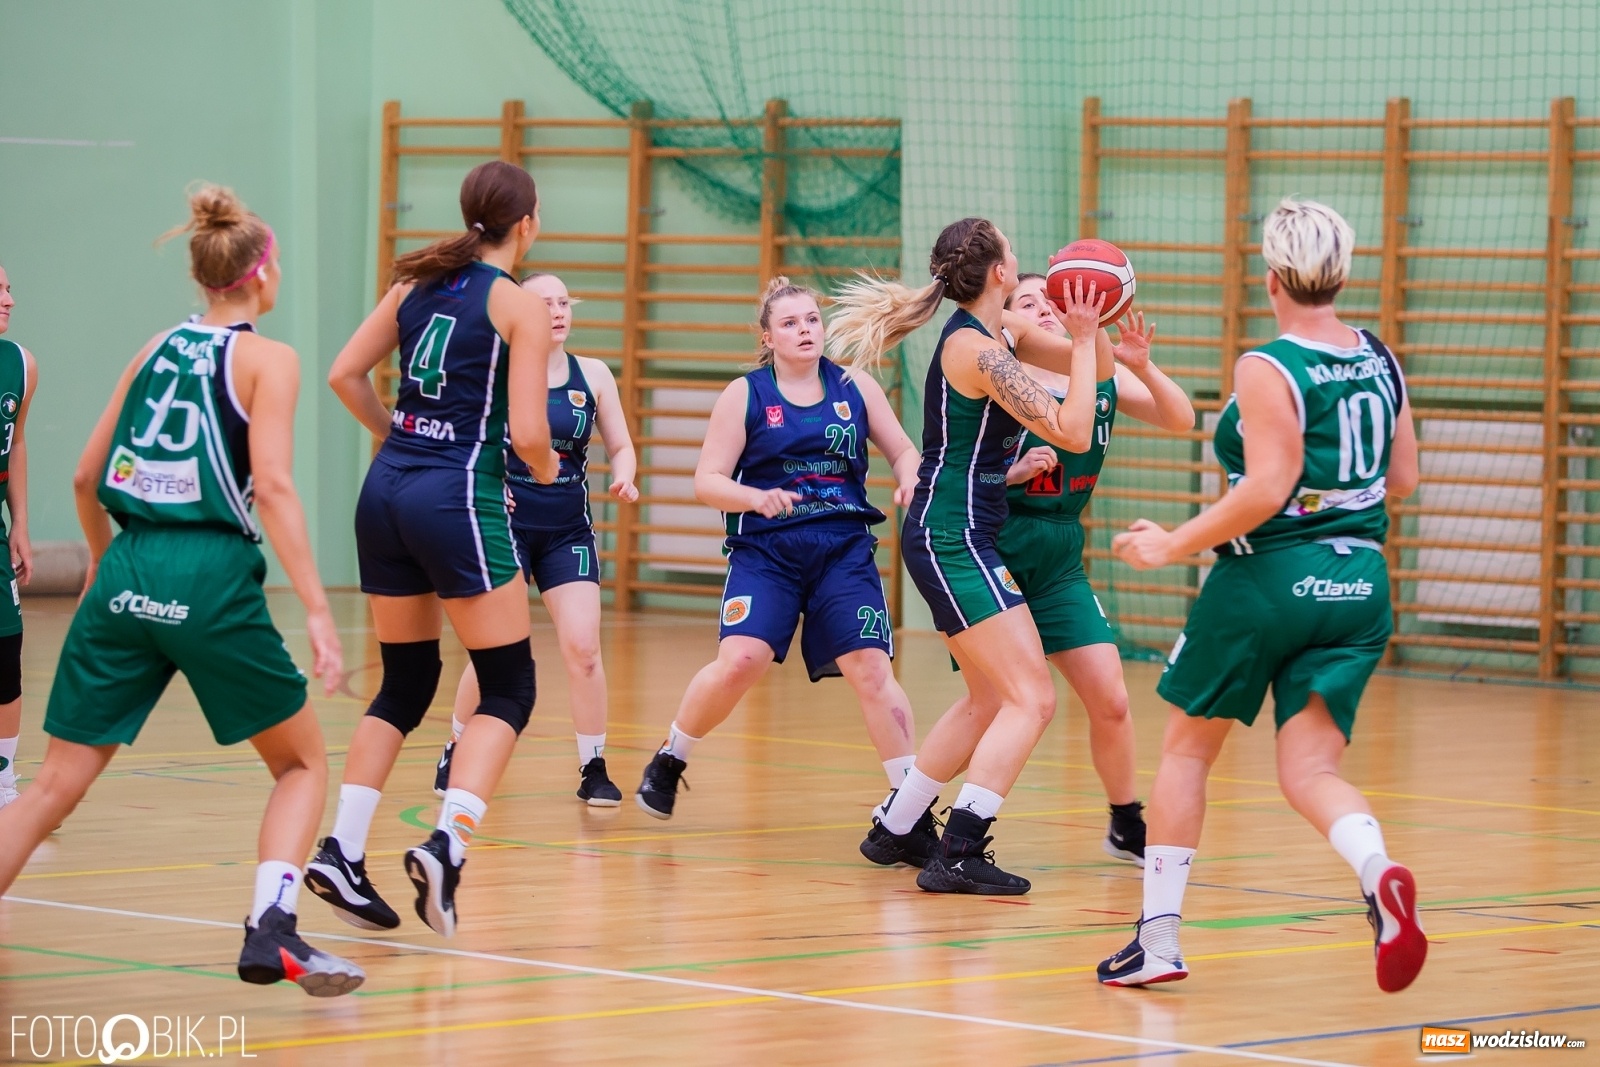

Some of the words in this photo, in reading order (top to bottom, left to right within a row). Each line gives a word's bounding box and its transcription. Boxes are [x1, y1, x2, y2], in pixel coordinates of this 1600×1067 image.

[408, 312, 457, 400] 4
[130, 355, 201, 451] 35
[572, 408, 587, 439] 7
[824, 423, 857, 459] 21
[1337, 391, 1385, 482] 10
[572, 545, 590, 576] 7
[1312, 578, 1374, 596] Clavis
[128, 594, 190, 620] Clavis
[857, 605, 889, 643] 21
